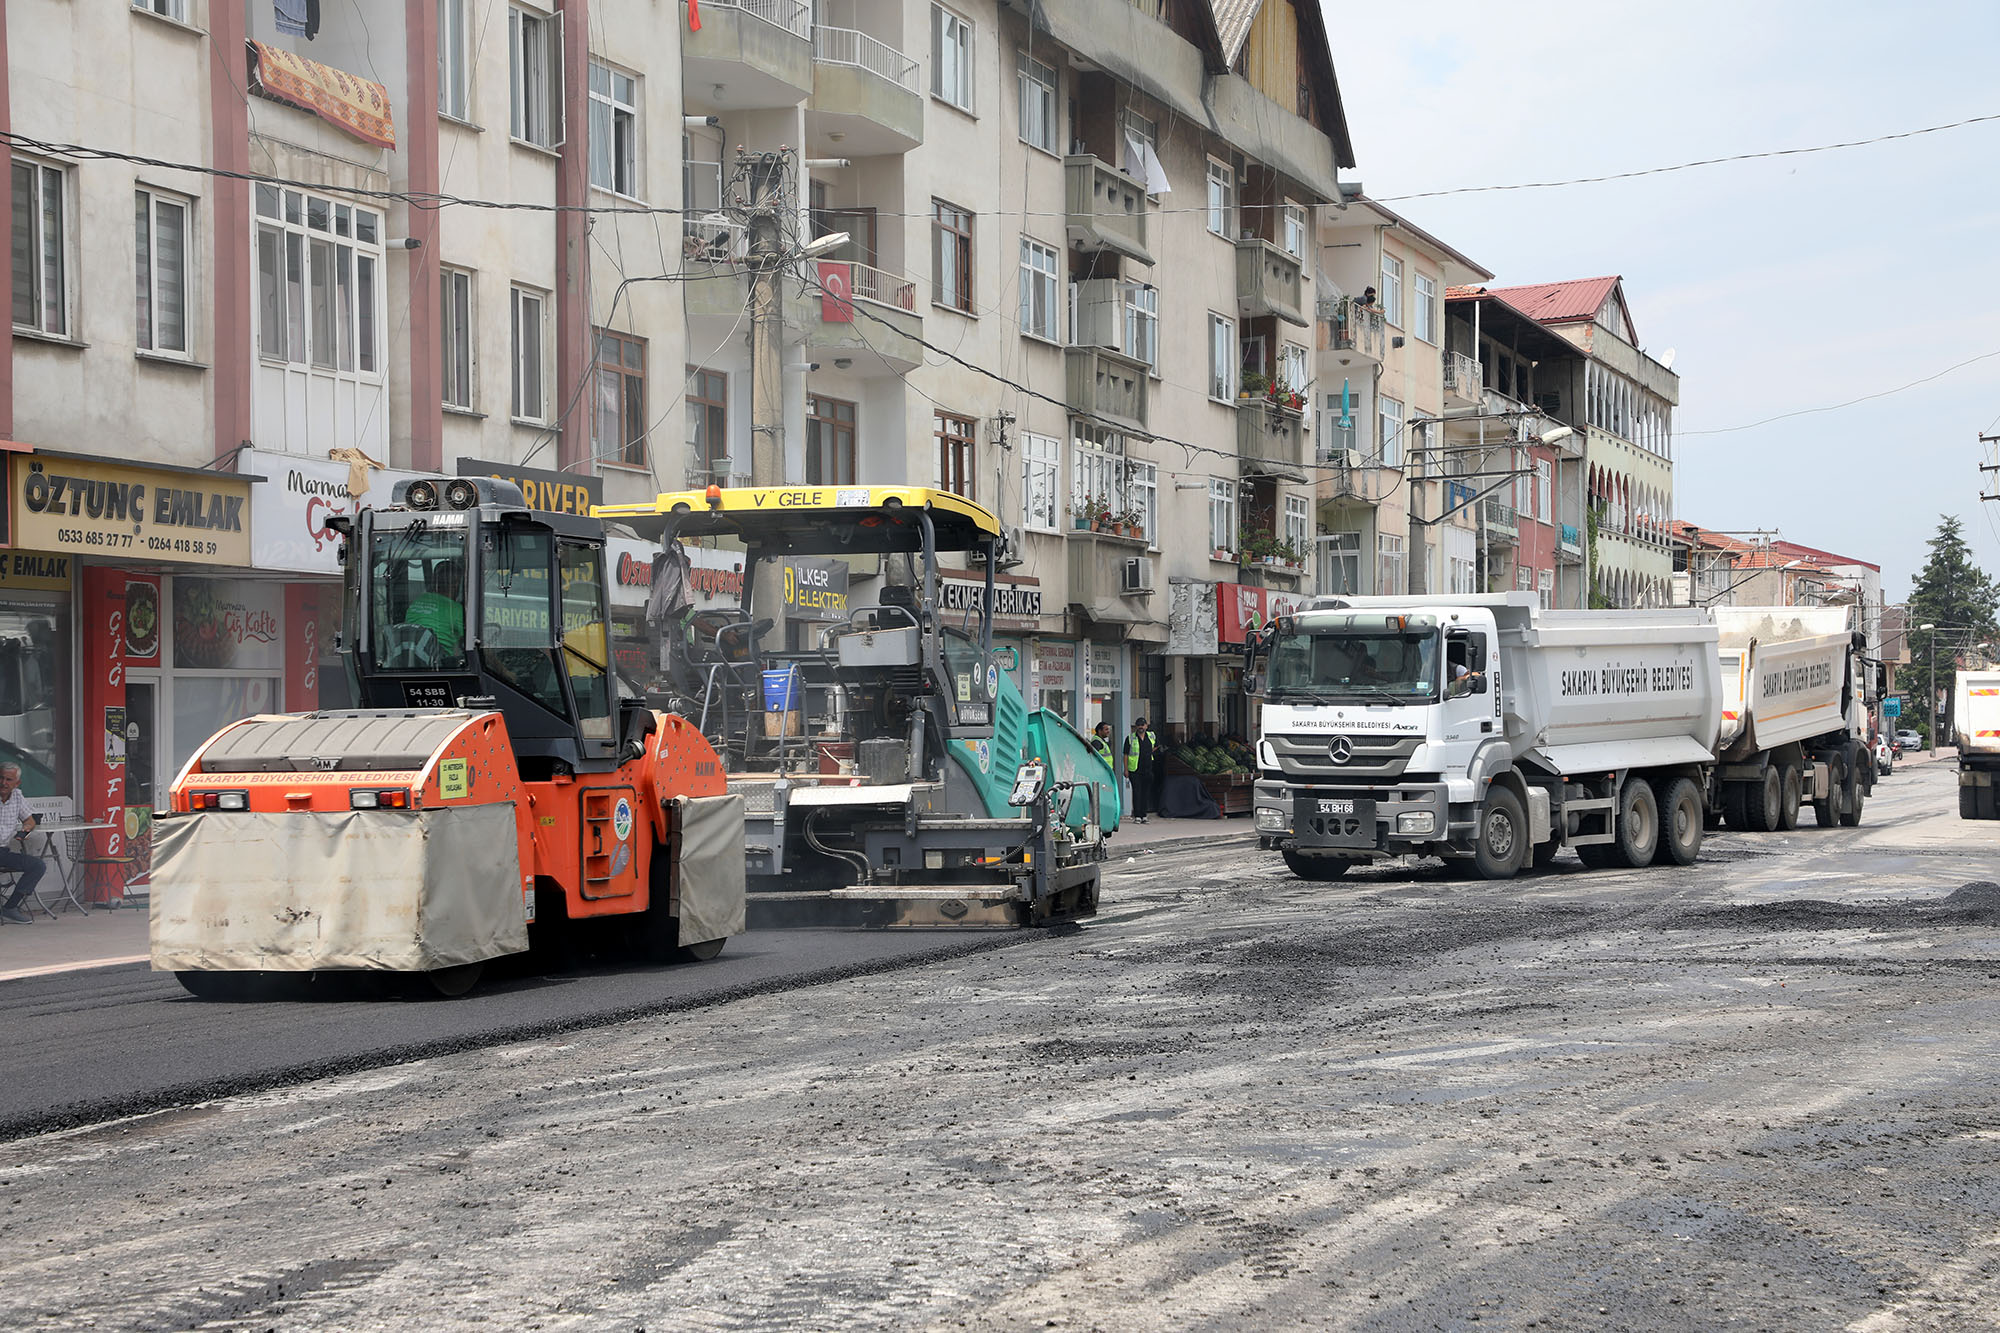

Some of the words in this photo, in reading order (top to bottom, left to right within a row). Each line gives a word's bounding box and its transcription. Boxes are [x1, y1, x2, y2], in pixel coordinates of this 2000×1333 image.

[24, 462, 144, 535] ÖZTUNÇ
[153, 487, 244, 533] EMLAK
[491, 474, 590, 516] RIYER
[432, 514, 463, 525] HAMM
[58, 528, 83, 544] 0533
[85, 531, 104, 546] 685
[106, 533, 119, 547] 27
[121, 534, 134, 549] 77
[148, 537, 172, 551] 0264
[174, 539, 191, 553] 418
[192, 542, 204, 555] 58
[206, 541, 218, 555] 59
[13, 555, 68, 578] EMLAK
[798, 567, 829, 587] İLKER
[947, 584, 985, 611] EKMEK
[993, 584, 1042, 615] ABRİKASI
[485, 607, 537, 628] SARIYER
[108, 610, 122, 688] ÇİĞ
[1562, 670, 1597, 696] SAKARYA
[1602, 661, 1648, 696] BÜYÜKŞEHİR
[1652, 659, 1693, 692] BELEDİYESİ
[1763, 672, 1782, 698] SAKARYA
[424, 688, 446, 696] SBB
[416, 699, 444, 707] 11-30
[1318, 720, 1356, 729] BÜYÜKŞEHİR
[1356, 720, 1391, 729] BELEDİYESİ
[187, 775, 247, 784] SAKARYA
[339, 773, 416, 782] BELEDİYESİ
[695, 761, 715, 776] HAMM
[1320, 804, 1330, 813] 54
[1332, 804, 1344, 813] BH
